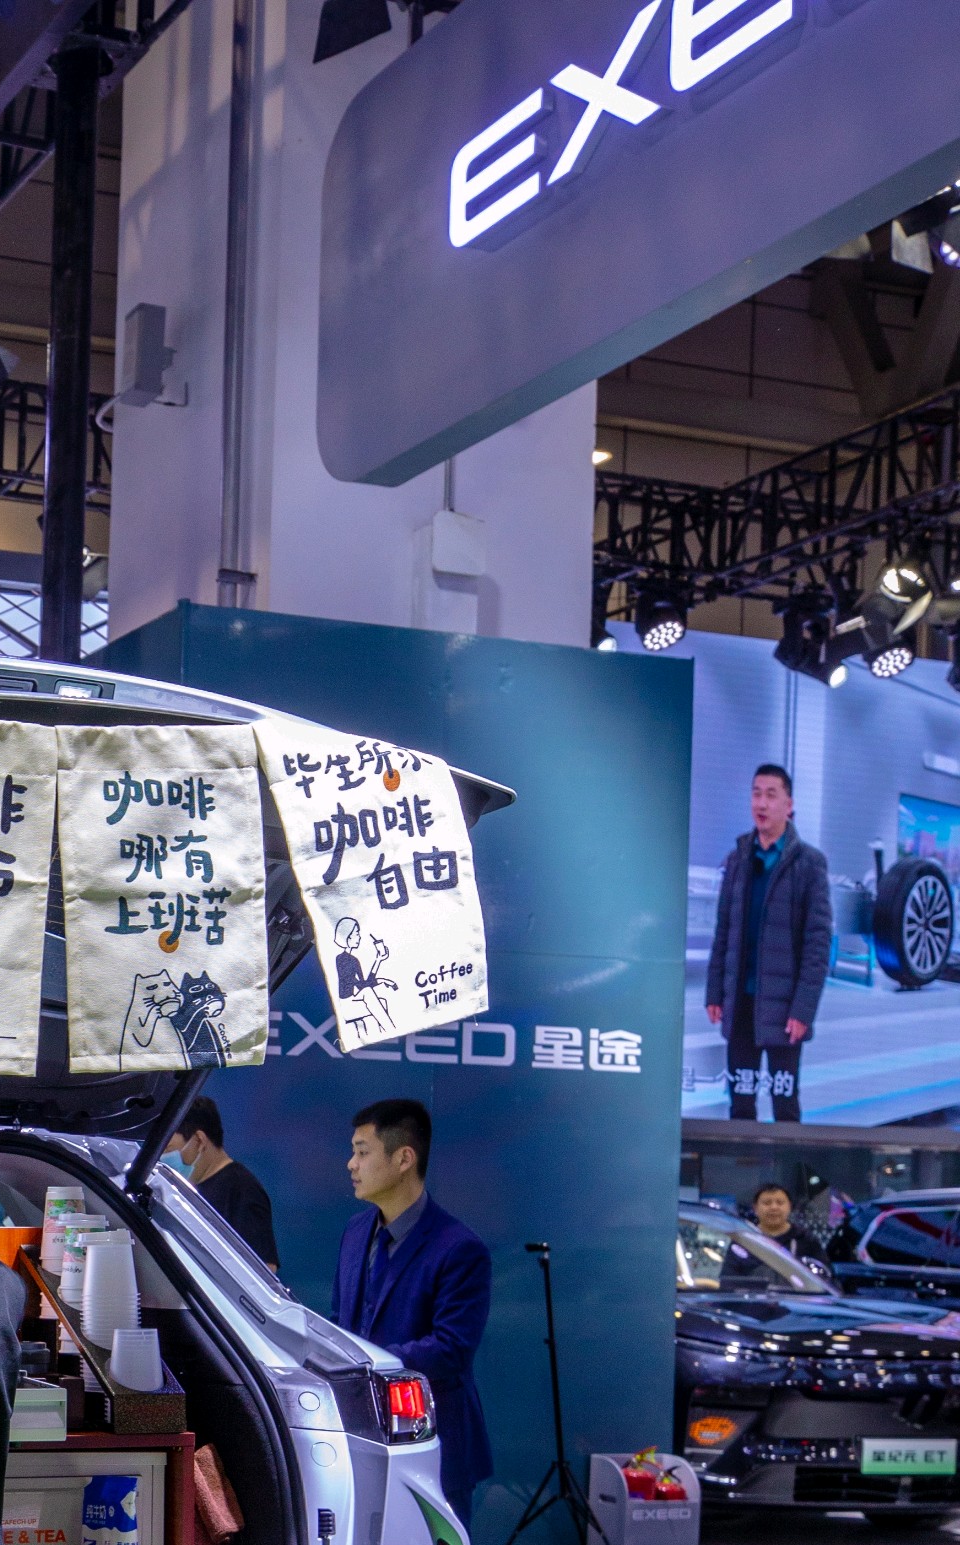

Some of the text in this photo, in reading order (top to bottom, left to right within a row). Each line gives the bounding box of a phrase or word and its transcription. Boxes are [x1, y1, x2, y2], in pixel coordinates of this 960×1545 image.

[103, 771, 216, 825] 咖啡
[120, 830, 214, 883] 哪有
[314, 794, 434, 885] 咖啡
[366, 846, 459, 910] 自由
[104, 887, 232, 945] 上班苦
[415, 962, 473, 988] Coffee
[419, 989, 457, 1009] Time
[531, 1025, 642, 1073] 星途
[924, 1449, 947, 1463] ET
[34, 1529, 66, 1543] TEA
[633, 1508, 691, 1520] EXEED
